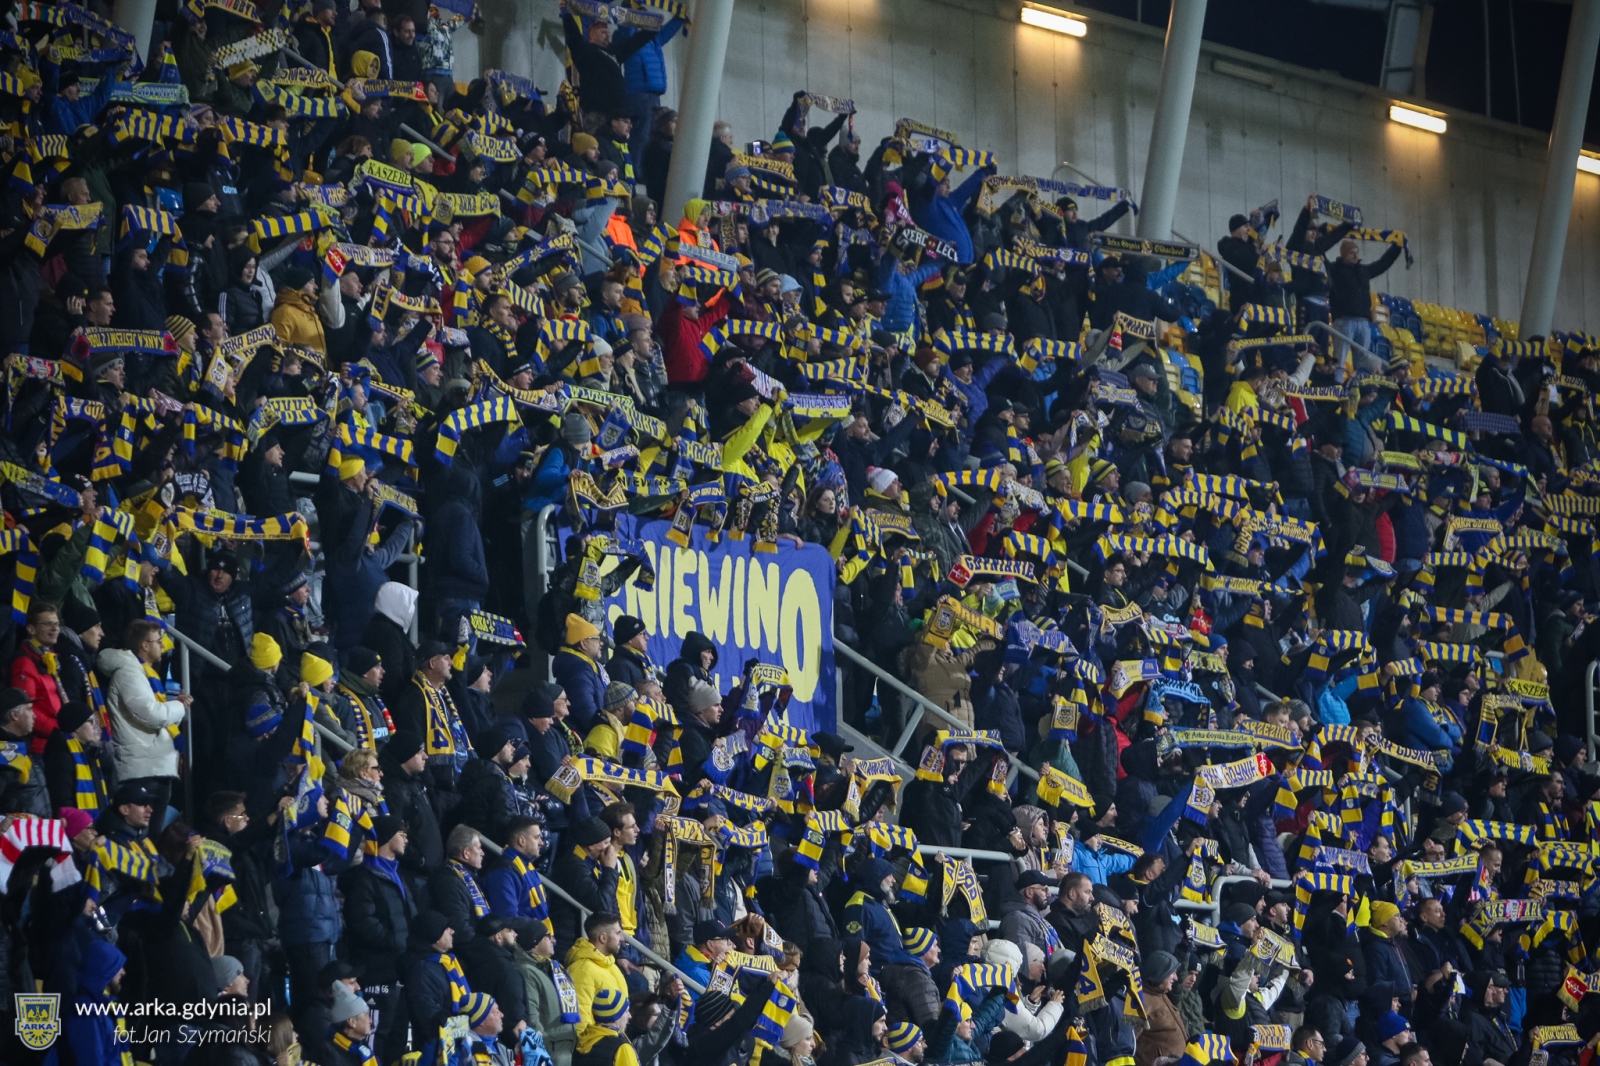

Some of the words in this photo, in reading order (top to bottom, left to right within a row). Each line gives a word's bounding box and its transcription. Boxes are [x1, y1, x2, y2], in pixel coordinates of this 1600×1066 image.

[136, 85, 176, 99] GDYNIA
[1106, 238, 1120, 248] Arka
[1122, 240, 1140, 250] Gdynia
[1154, 244, 1184, 256] Oldschool
[1345, 228, 1404, 248] RKA
[246, 325, 276, 346] GDYNI
[1225, 759, 1258, 784] GDYNIA
[1411, 855, 1476, 871] SLEDZIE
